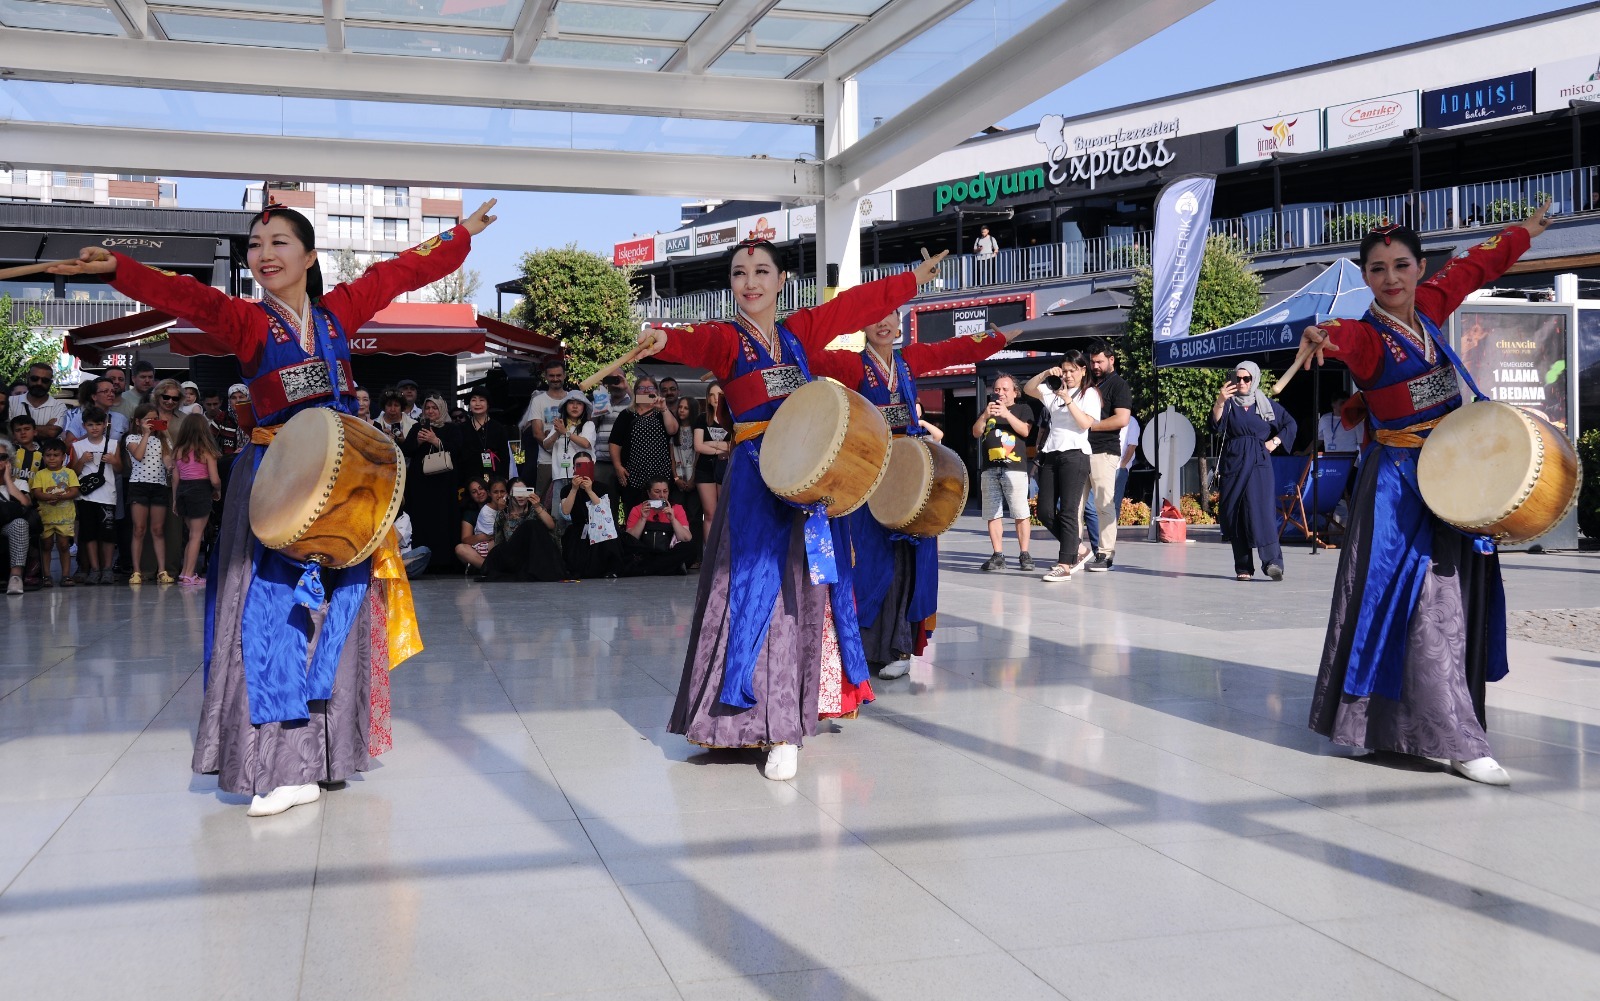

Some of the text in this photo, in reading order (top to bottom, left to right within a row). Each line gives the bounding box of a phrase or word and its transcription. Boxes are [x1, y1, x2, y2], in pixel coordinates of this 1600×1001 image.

[1560, 84, 1594, 97] misto
[1073, 118, 1180, 152] Bursa Lezzetleri
[1257, 136, 1279, 152] örnek
[935, 138, 1177, 213] podyum Express
[101, 238, 163, 249] ÖZGEN
[666, 237, 688, 250] AKAY
[618, 243, 650, 260] iskender
[954, 310, 986, 320] PODYUM
[347, 338, 378, 350] KIZ
[1492, 369, 1539, 383] 1 ALANA
[1490, 387, 1546, 401] 1 BEDAVA
